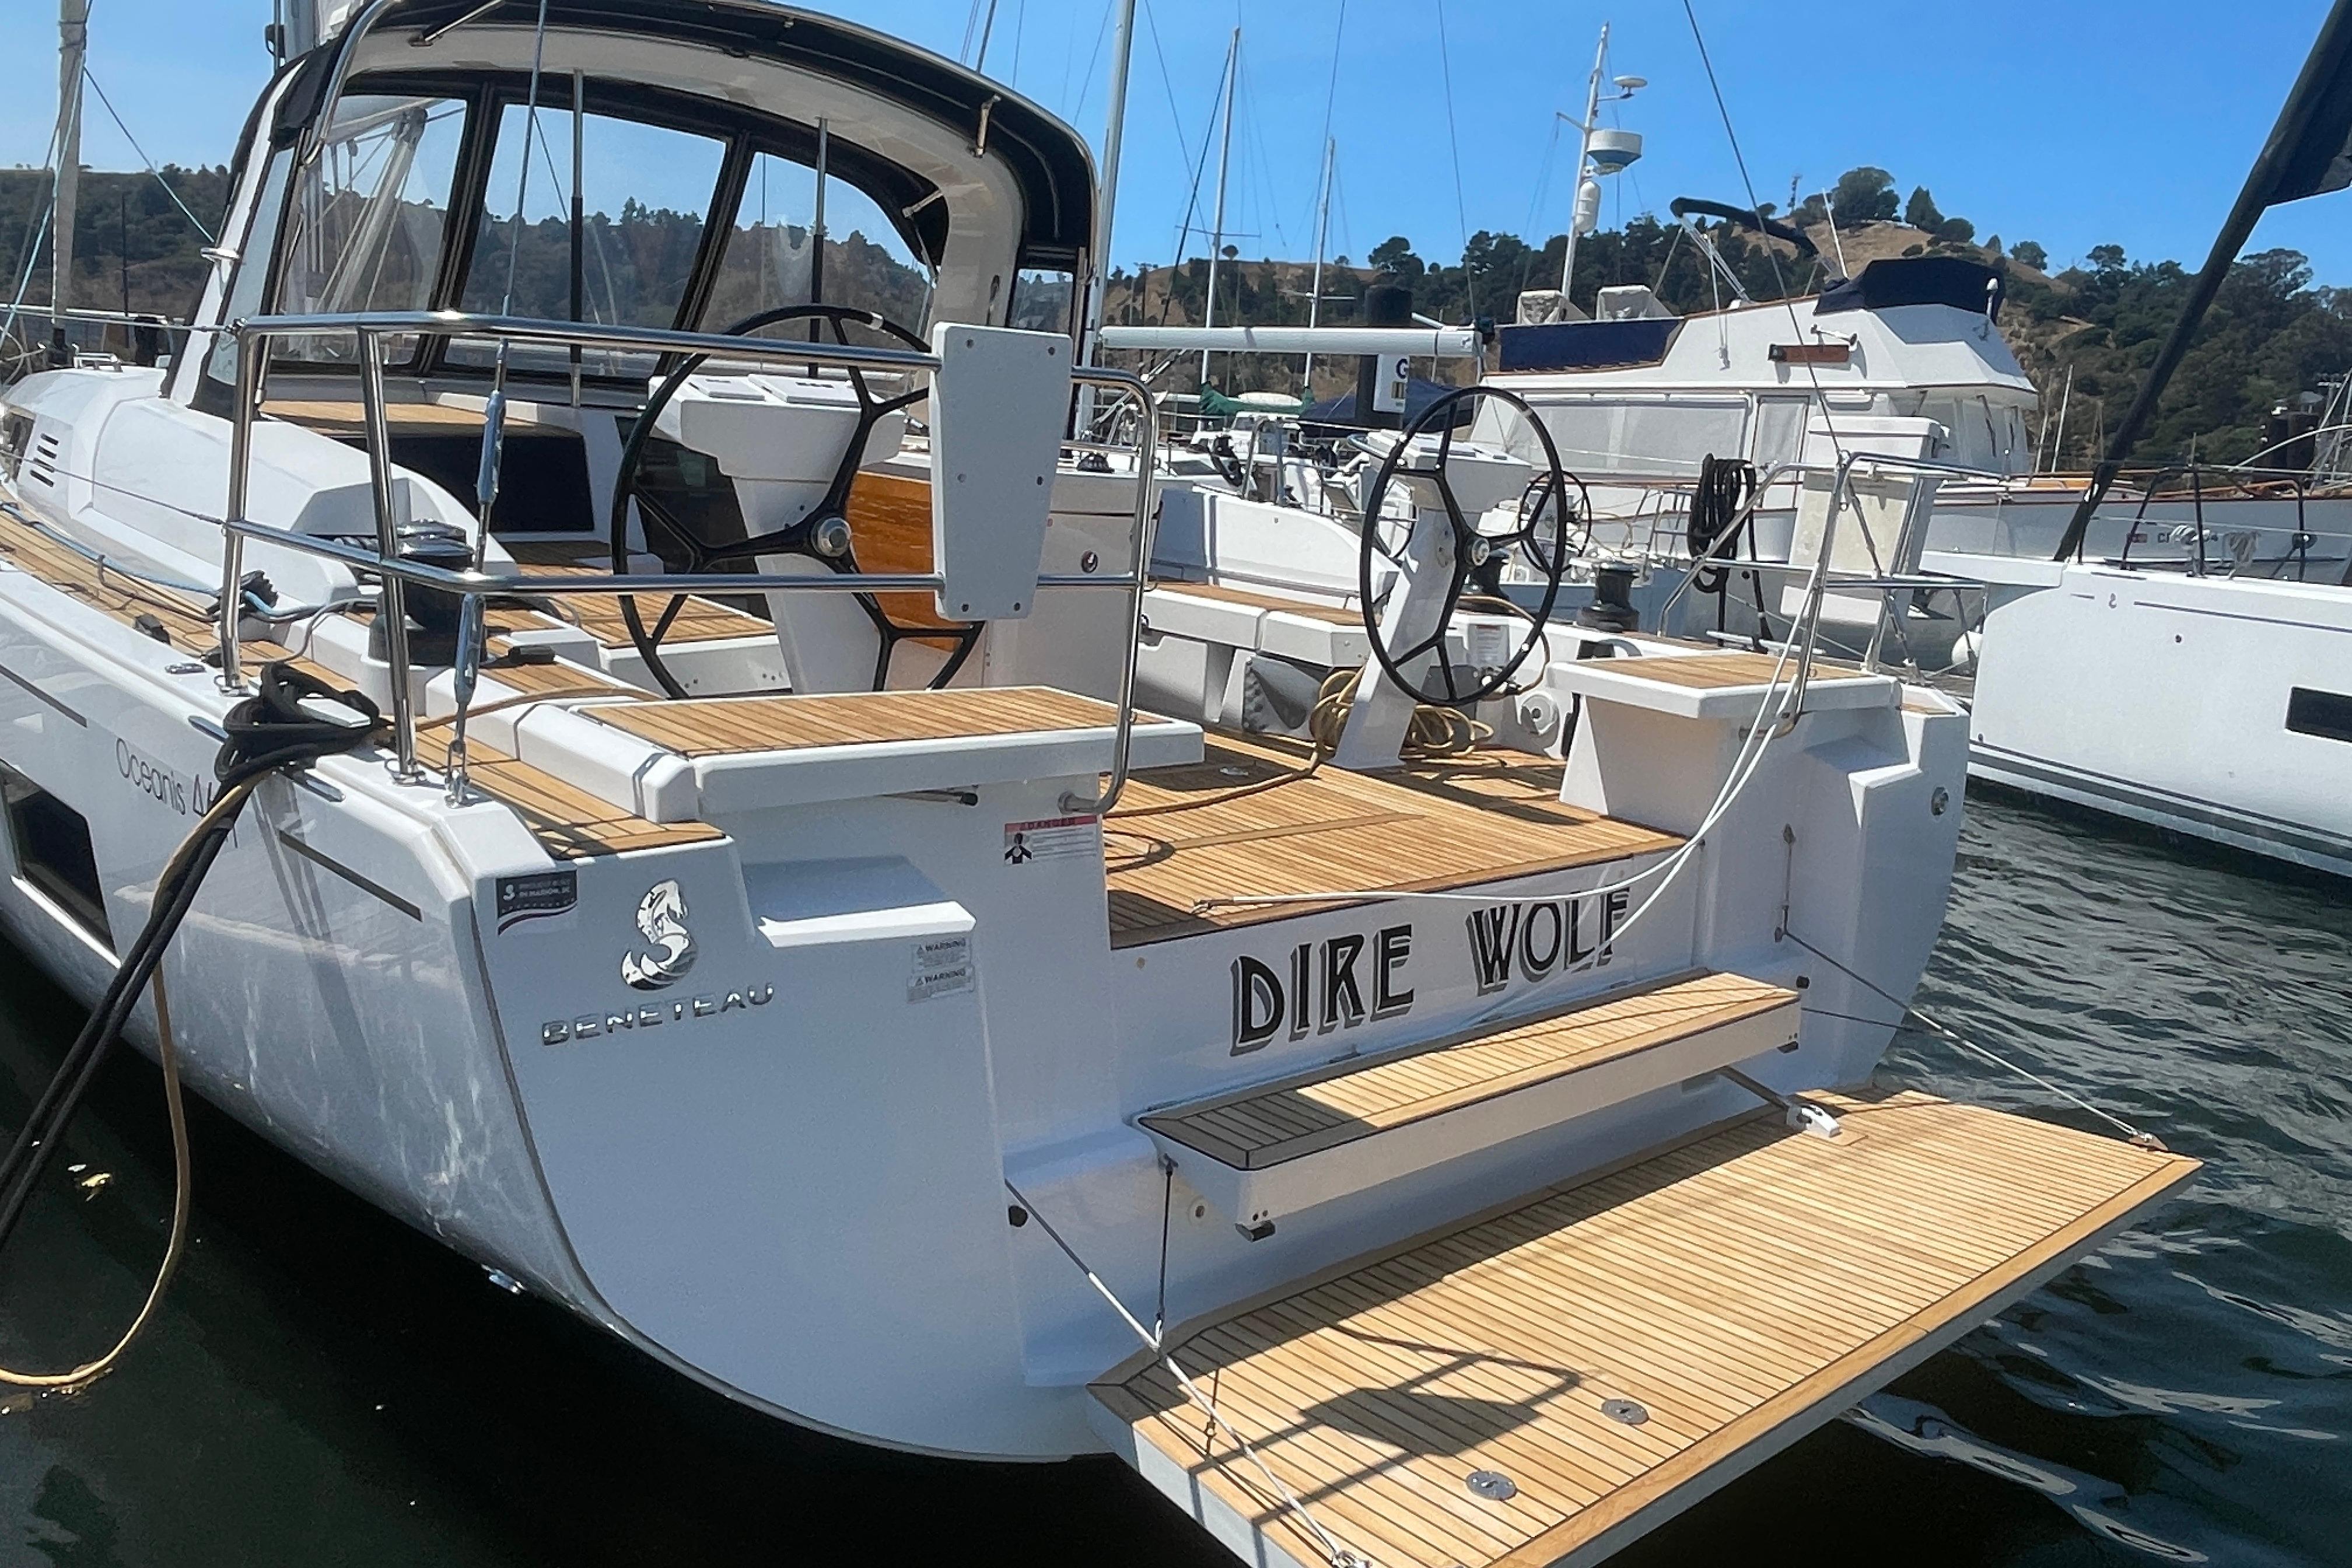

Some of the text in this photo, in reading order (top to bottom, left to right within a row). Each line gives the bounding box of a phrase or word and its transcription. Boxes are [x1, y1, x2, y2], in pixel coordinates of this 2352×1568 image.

[117, 737, 186, 816] Oceanis
[924, 966, 966, 983] WARNING
[925, 937, 966, 952] WARNING
[1230, 887, 1630, 1056] DIRE WOLF
[542, 982, 774, 1046] BENETEAU
